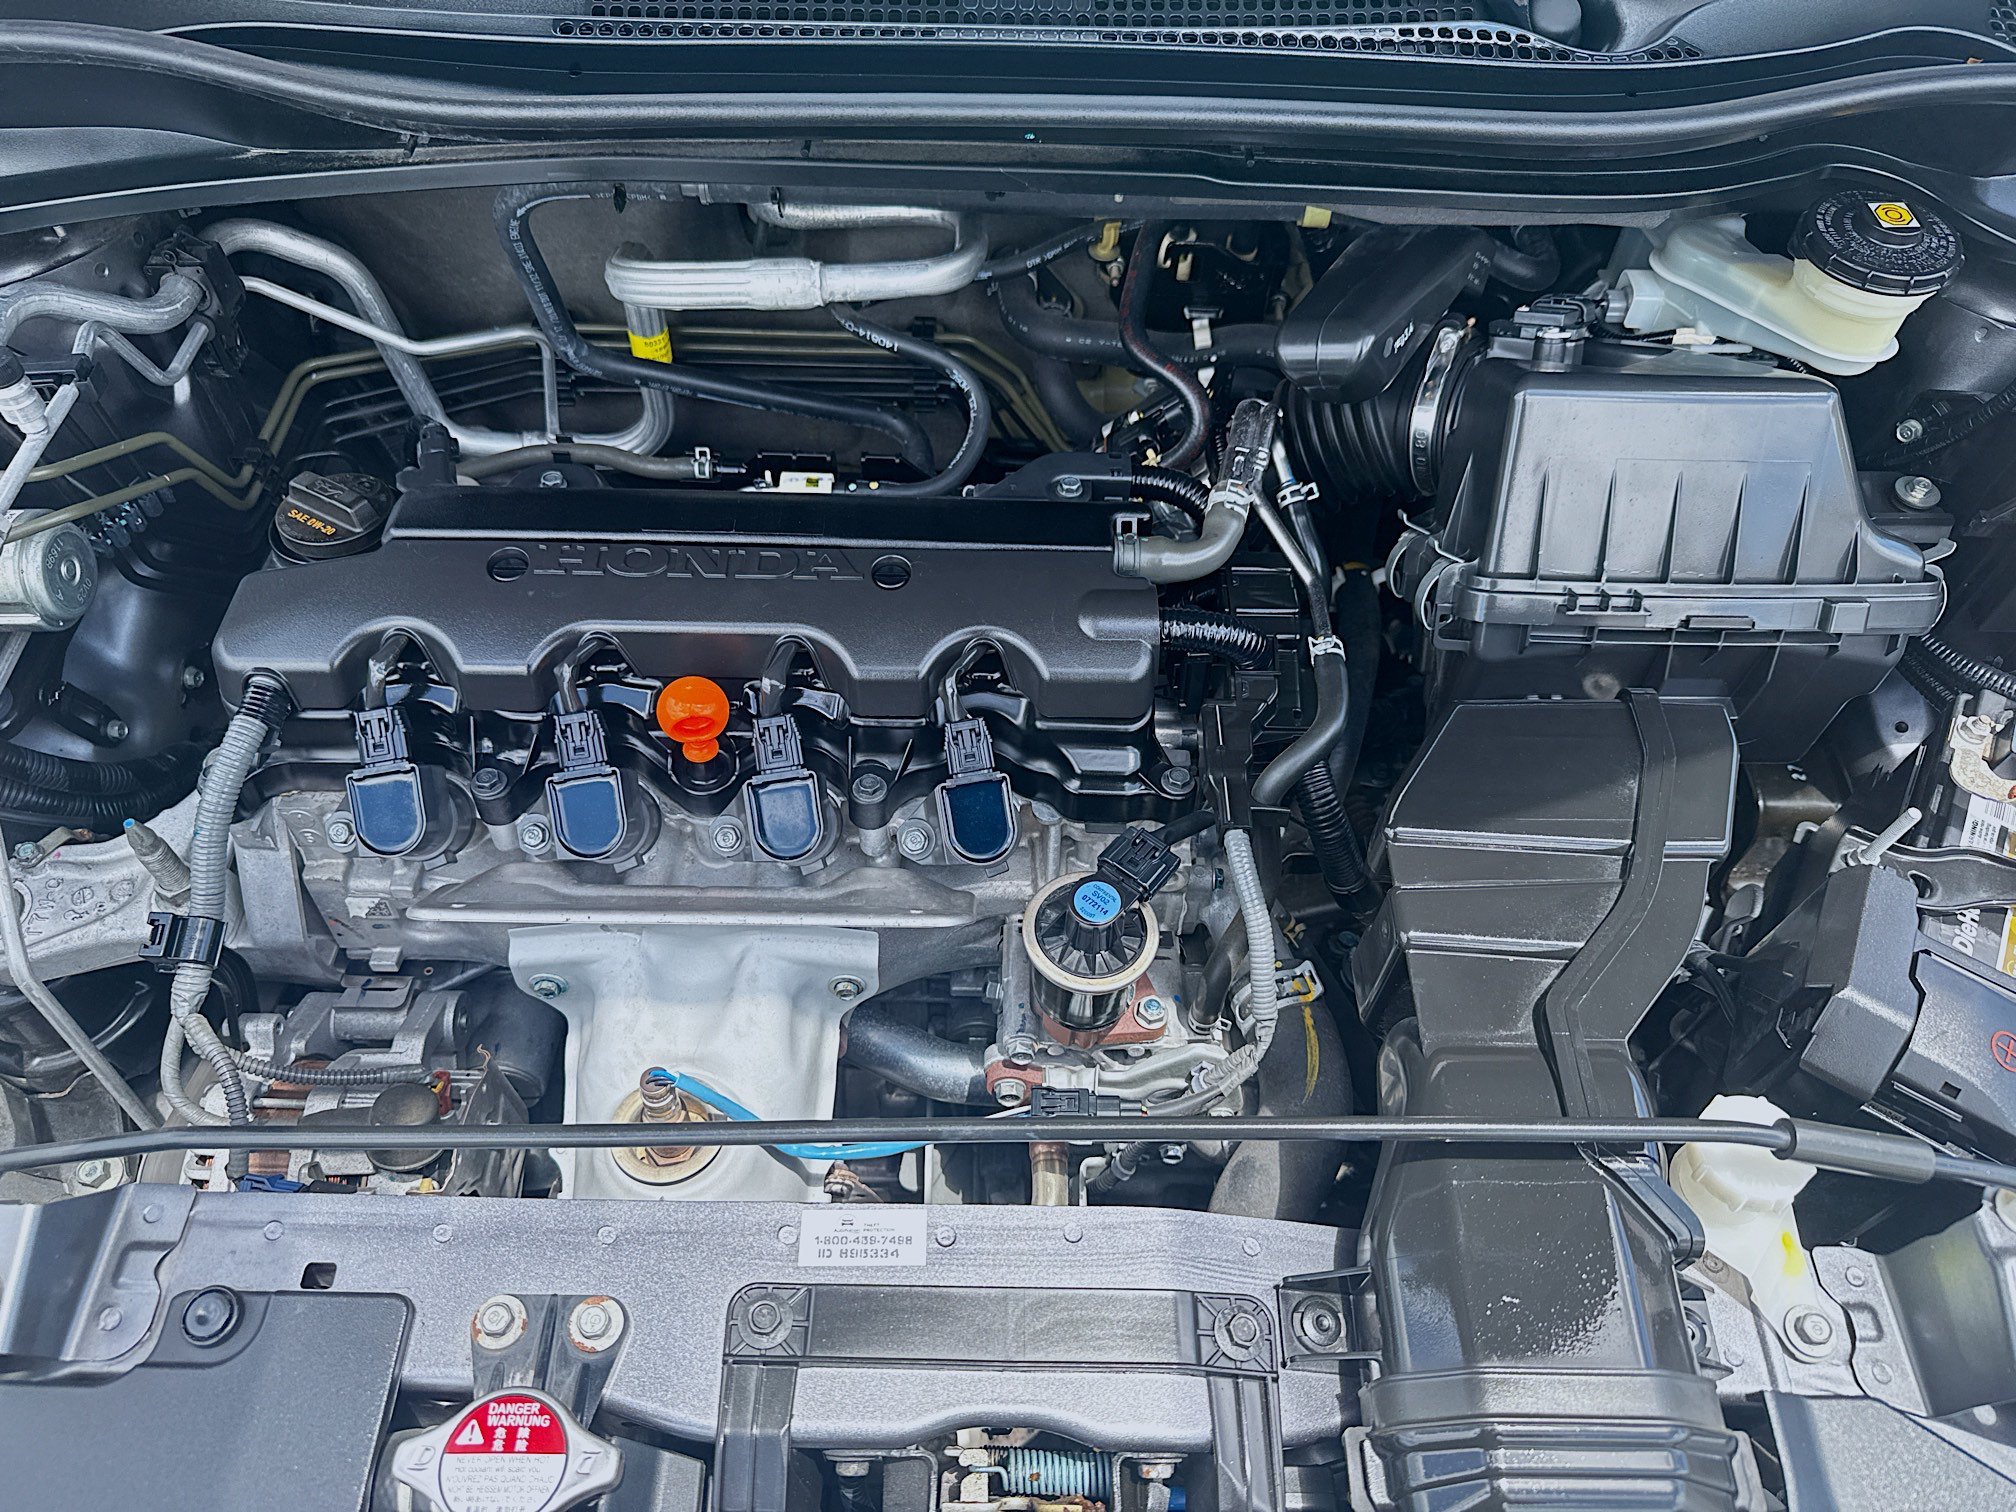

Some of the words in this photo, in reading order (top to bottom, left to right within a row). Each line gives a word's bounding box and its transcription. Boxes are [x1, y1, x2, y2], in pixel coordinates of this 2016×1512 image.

[286, 508, 311, 524] SAE
[306, 517, 337, 536] 0W-20
[533, 544, 865, 581] HONDA
[1091, 890, 1110, 906] SV02
[488, 1402, 541, 1415] DANGER
[487, 1414, 551, 1428] WARNUNG
[508, 1456, 531, 1464] WHEN
